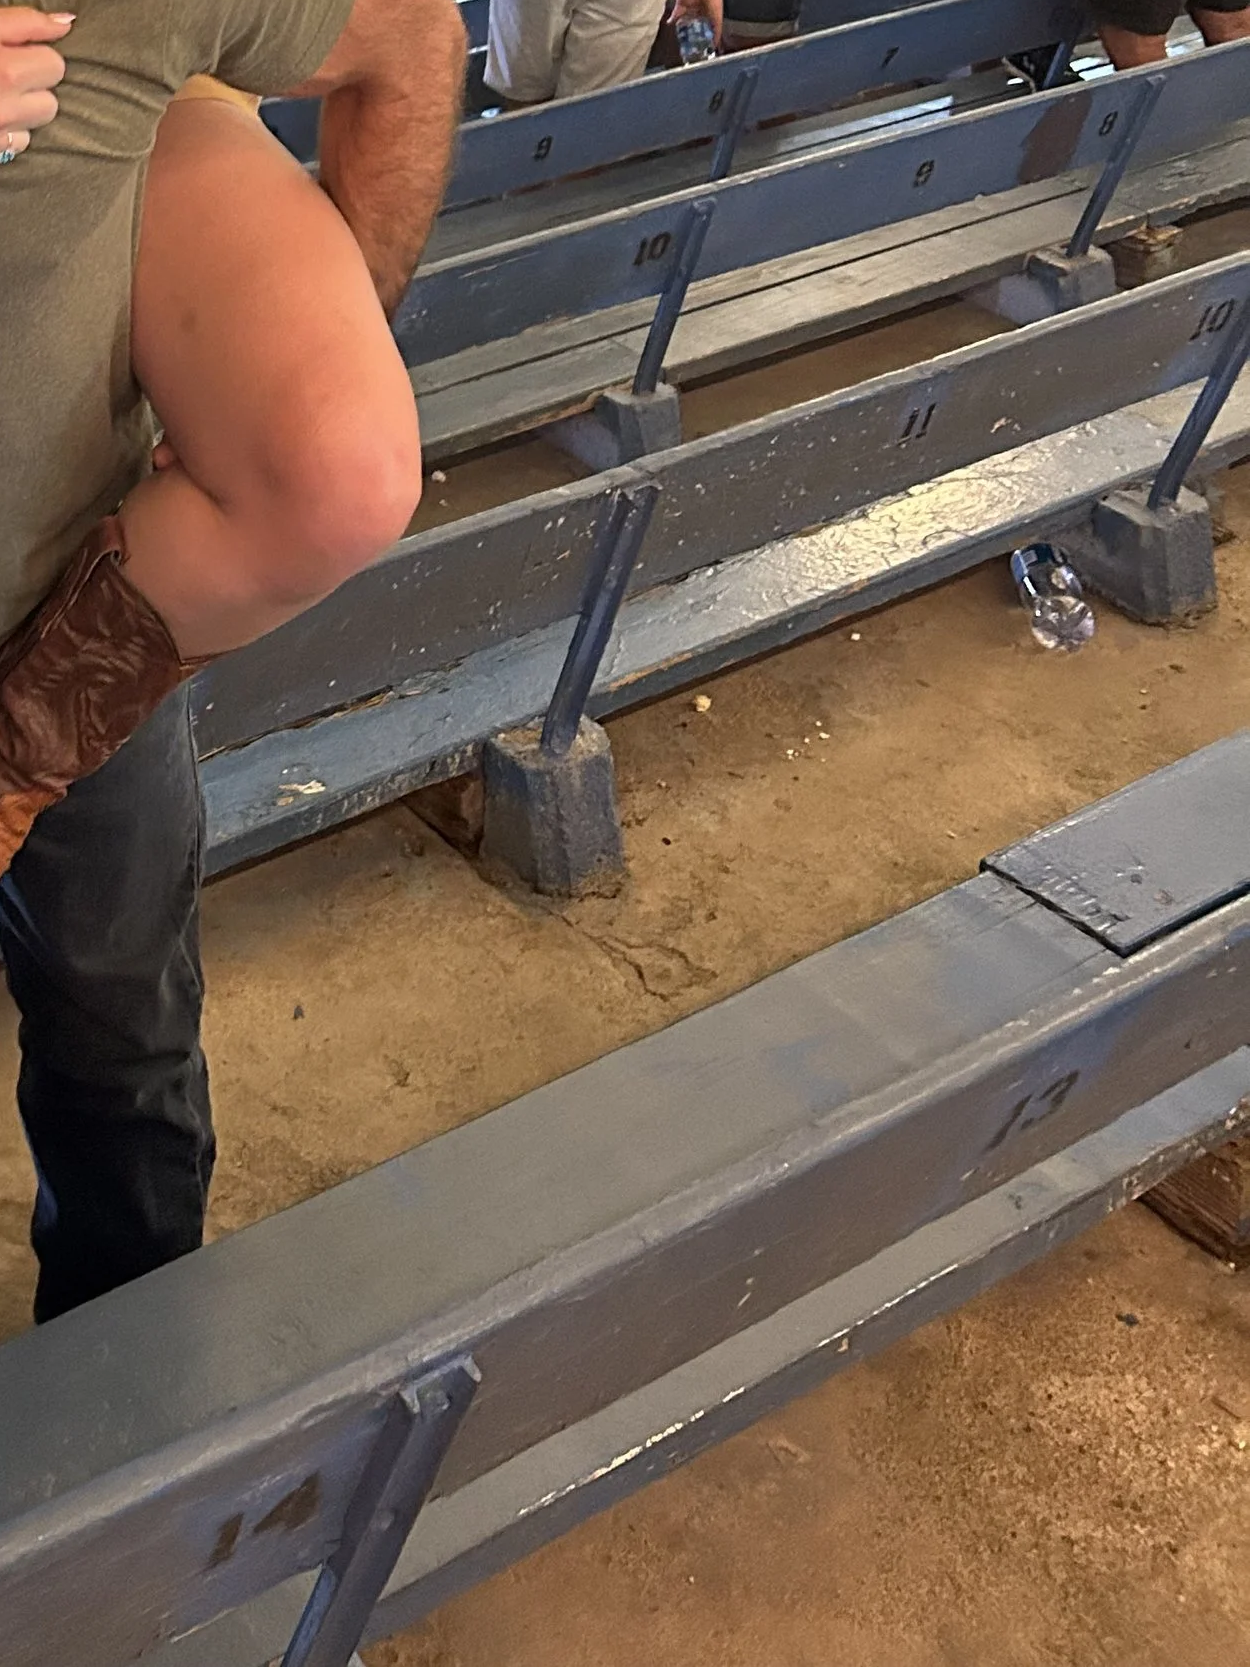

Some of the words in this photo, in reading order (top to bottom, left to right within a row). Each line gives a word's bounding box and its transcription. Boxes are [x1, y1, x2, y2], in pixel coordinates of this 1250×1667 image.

[880, 46, 899, 69] 7
[1098, 110, 1118, 136] 8
[533, 135, 553, 161] 9
[633, 231, 671, 266] 10
[1188, 298, 1235, 342] 10
[900, 401, 937, 440] 11
[982, 1070, 1080, 1154] 13
[208, 1471, 320, 1573] 14
